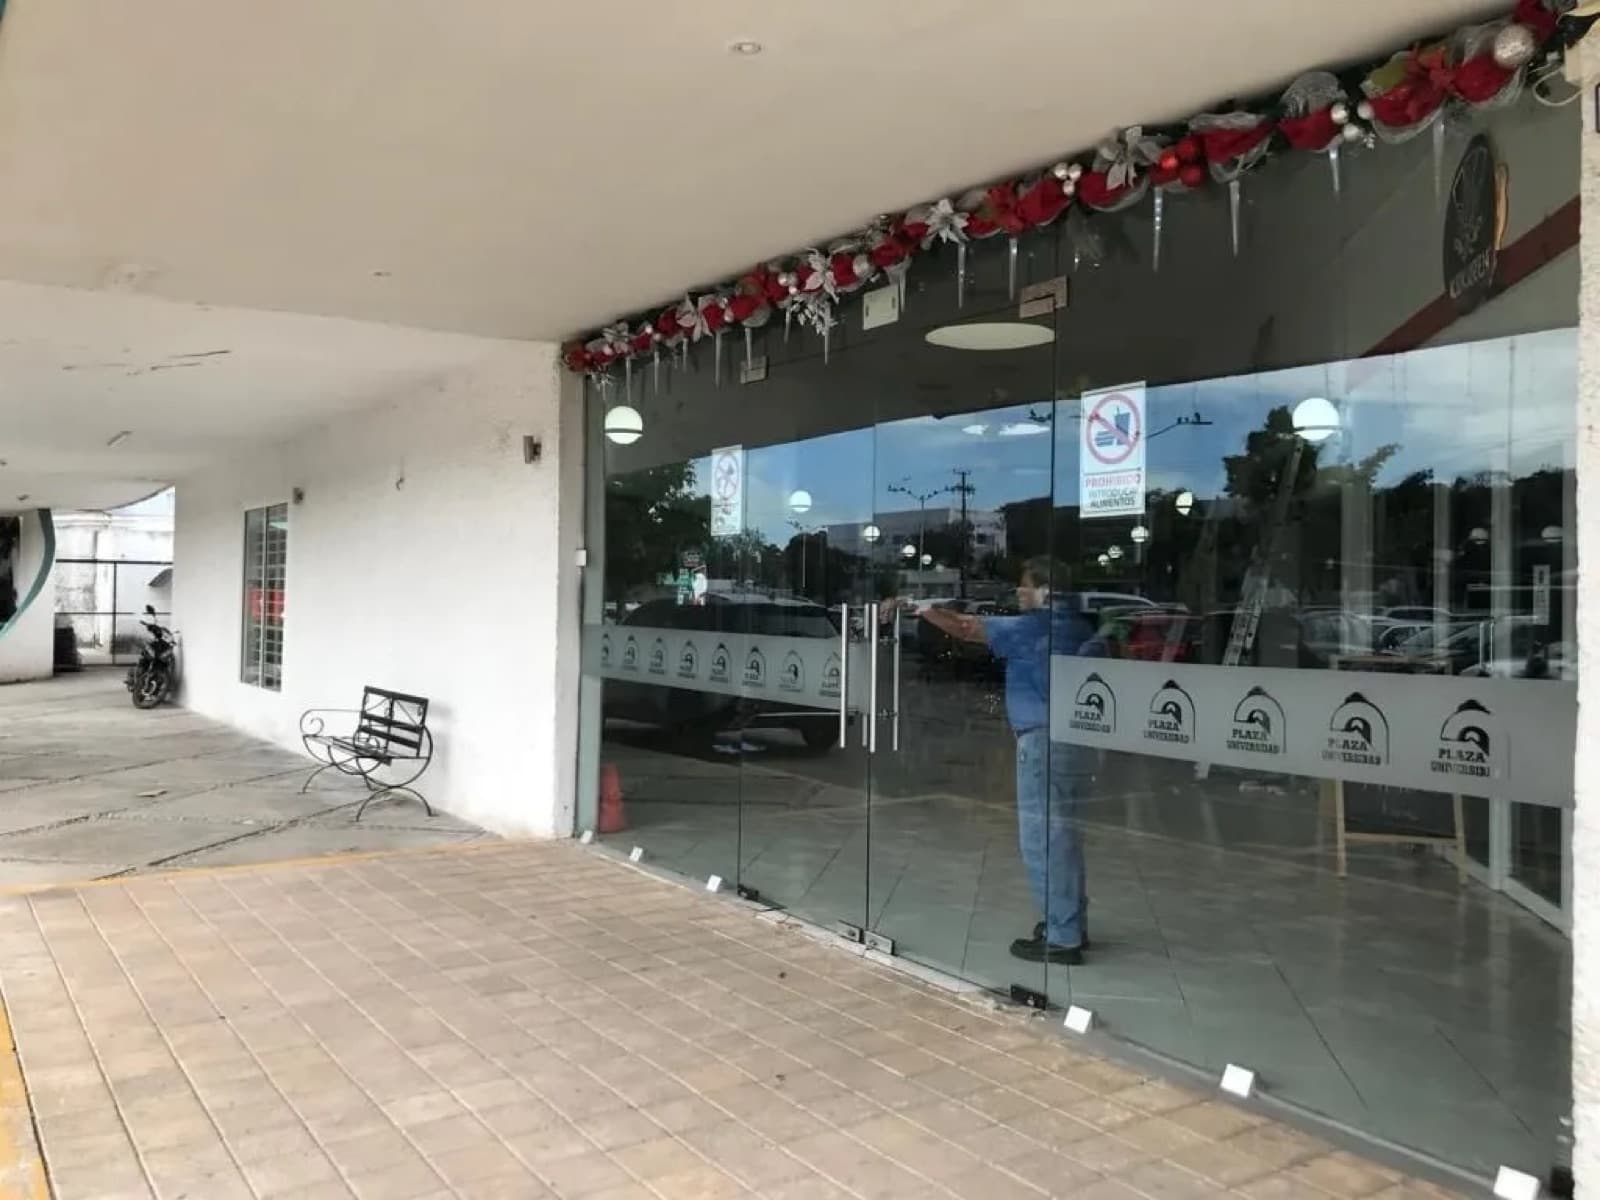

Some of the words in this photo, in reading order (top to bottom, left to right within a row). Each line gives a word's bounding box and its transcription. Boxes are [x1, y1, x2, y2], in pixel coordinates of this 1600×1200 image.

[1074, 709, 1102, 721] PLAZA
[1148, 719, 1179, 732] PLAZA
[1231, 727, 1268, 742] PLAZA
[1438, 748, 1486, 763] PLAZA
